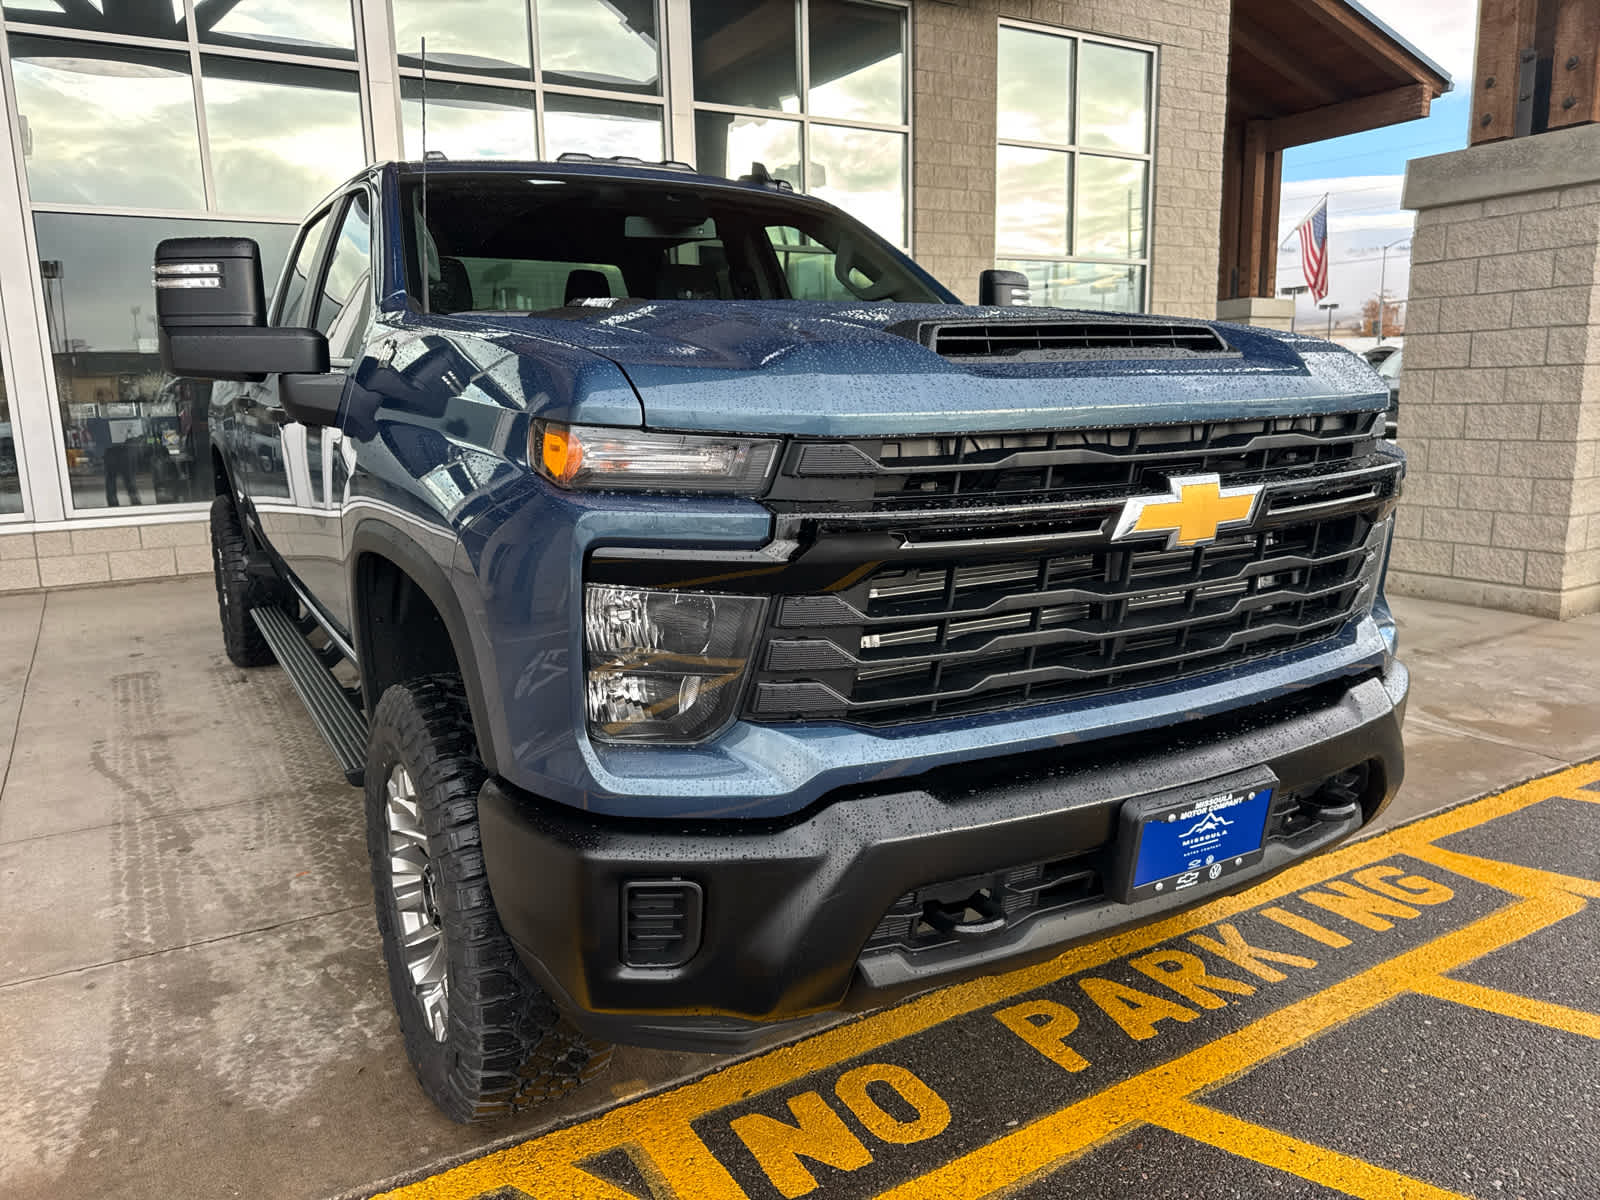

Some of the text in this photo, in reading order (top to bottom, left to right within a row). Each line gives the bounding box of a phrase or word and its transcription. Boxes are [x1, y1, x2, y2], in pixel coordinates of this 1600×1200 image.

[1208, 796, 1245, 812] COMPANY
[1182, 830, 1228, 846] MISSOULA
[729, 865, 1455, 1199] NO PARKING
